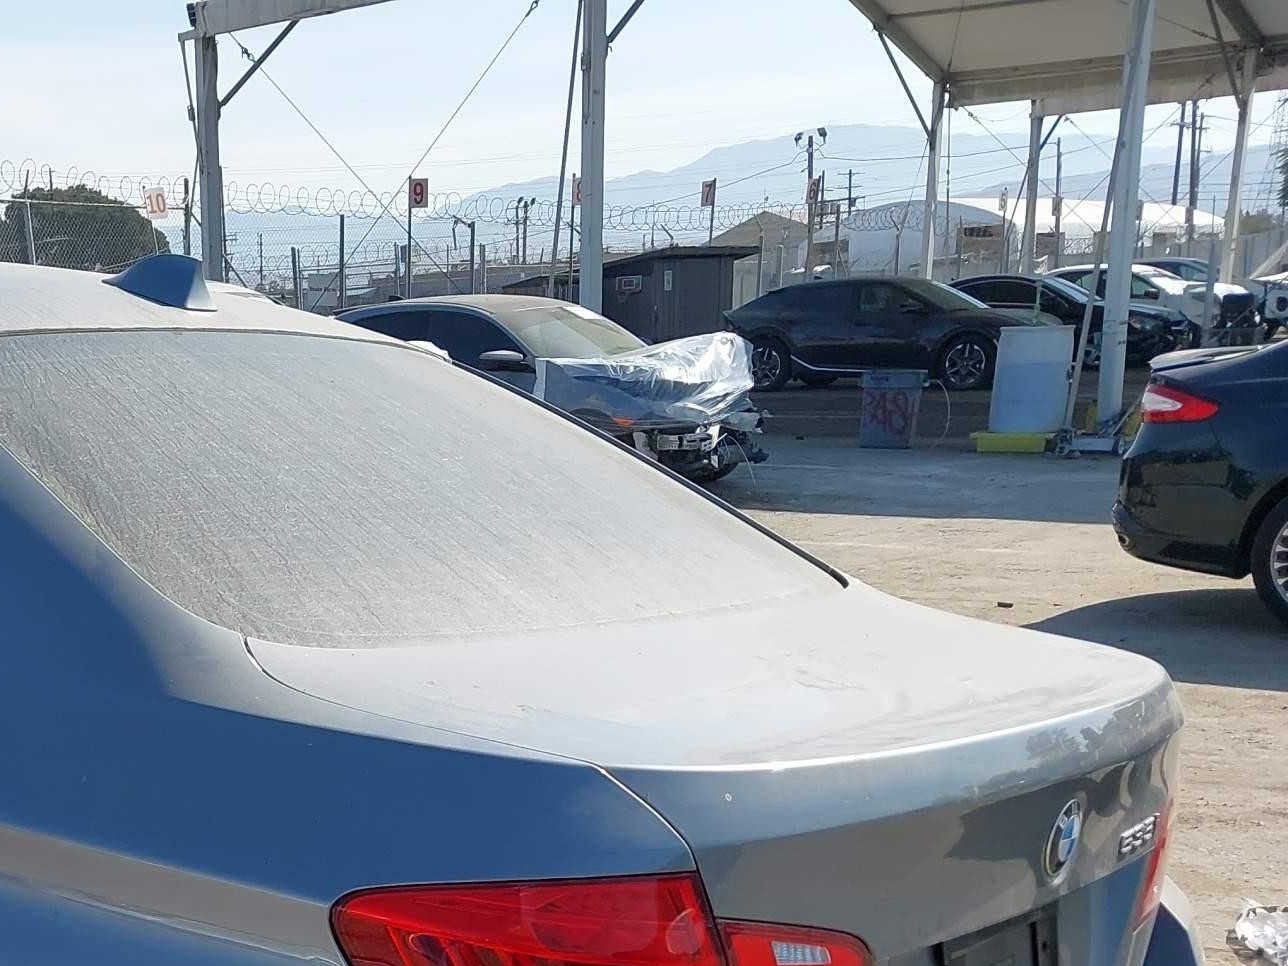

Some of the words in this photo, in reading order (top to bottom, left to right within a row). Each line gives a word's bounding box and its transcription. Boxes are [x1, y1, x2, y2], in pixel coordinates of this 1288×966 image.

[413, 182, 424, 204] 9
[705, 183, 713, 203] 7
[809, 182, 817, 200] 6
[146, 193, 166, 213] 10
